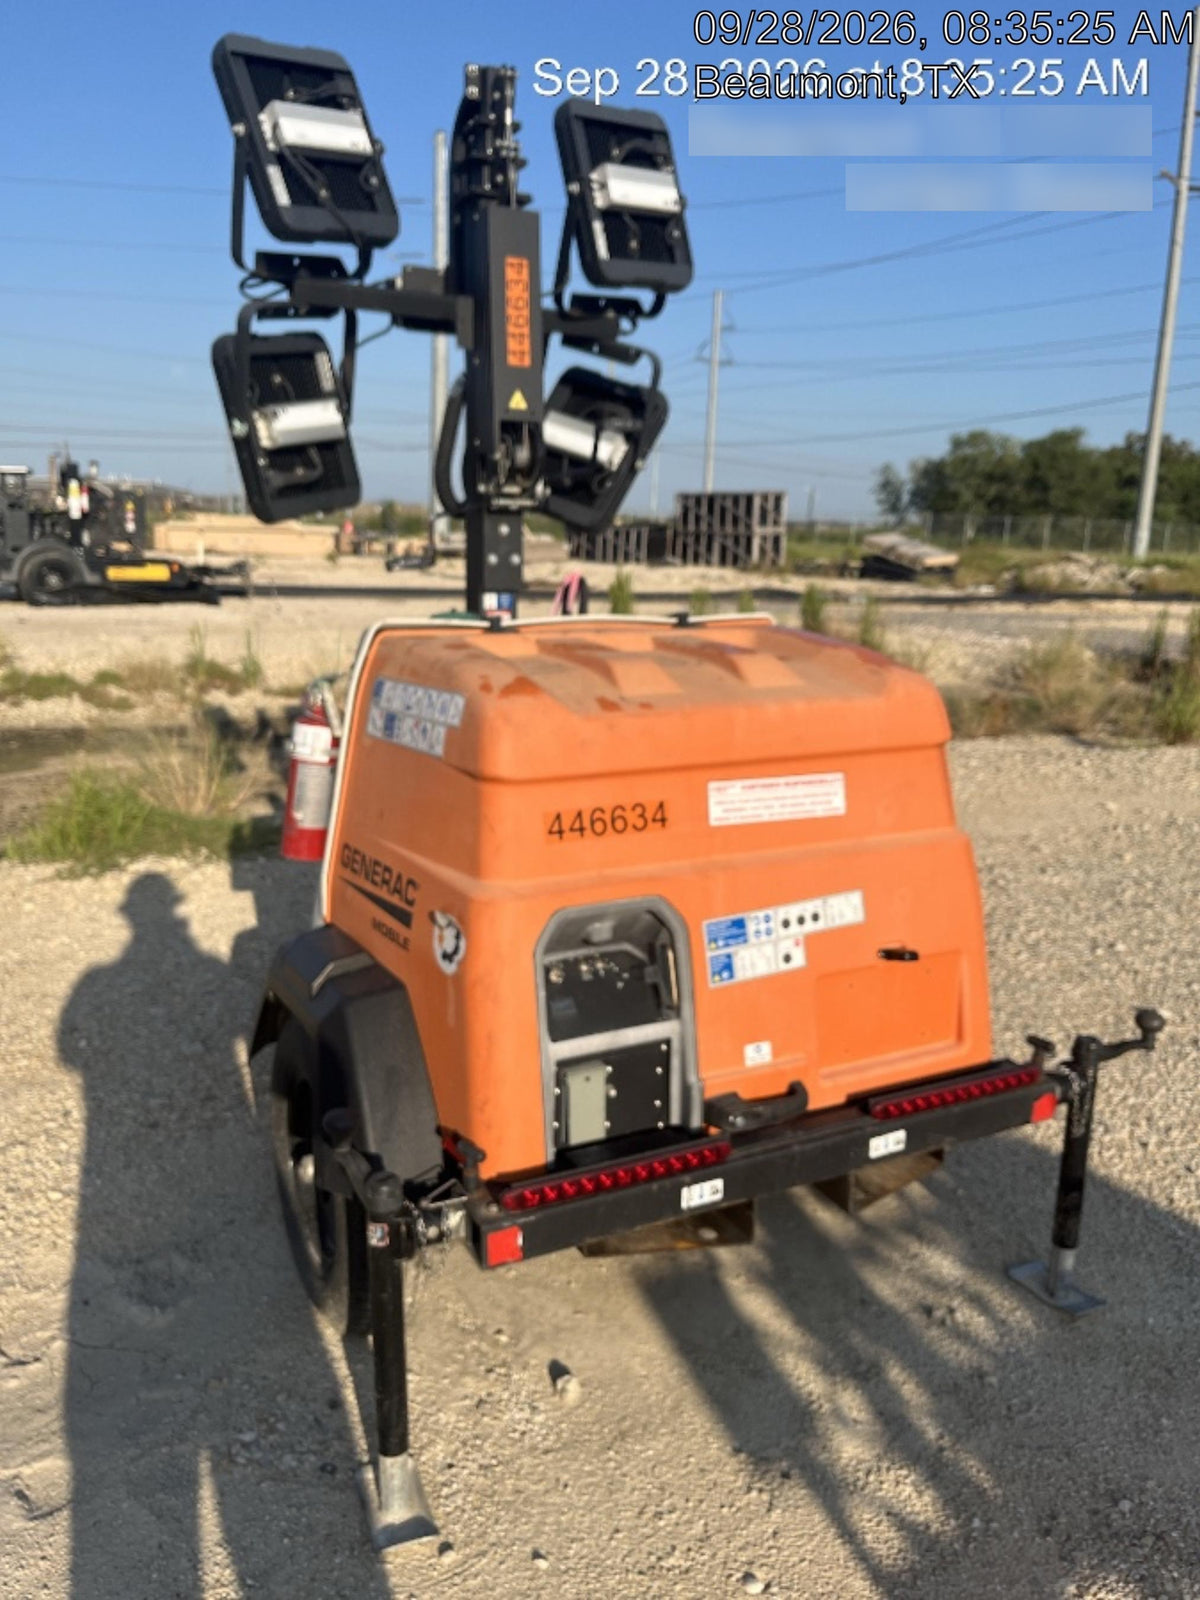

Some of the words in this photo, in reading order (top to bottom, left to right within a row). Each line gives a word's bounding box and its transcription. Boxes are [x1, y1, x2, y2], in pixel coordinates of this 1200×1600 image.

[547, 800, 669, 841] 446634
[341, 843, 417, 906] GENERAC
[371, 916, 411, 952] MOBILE
